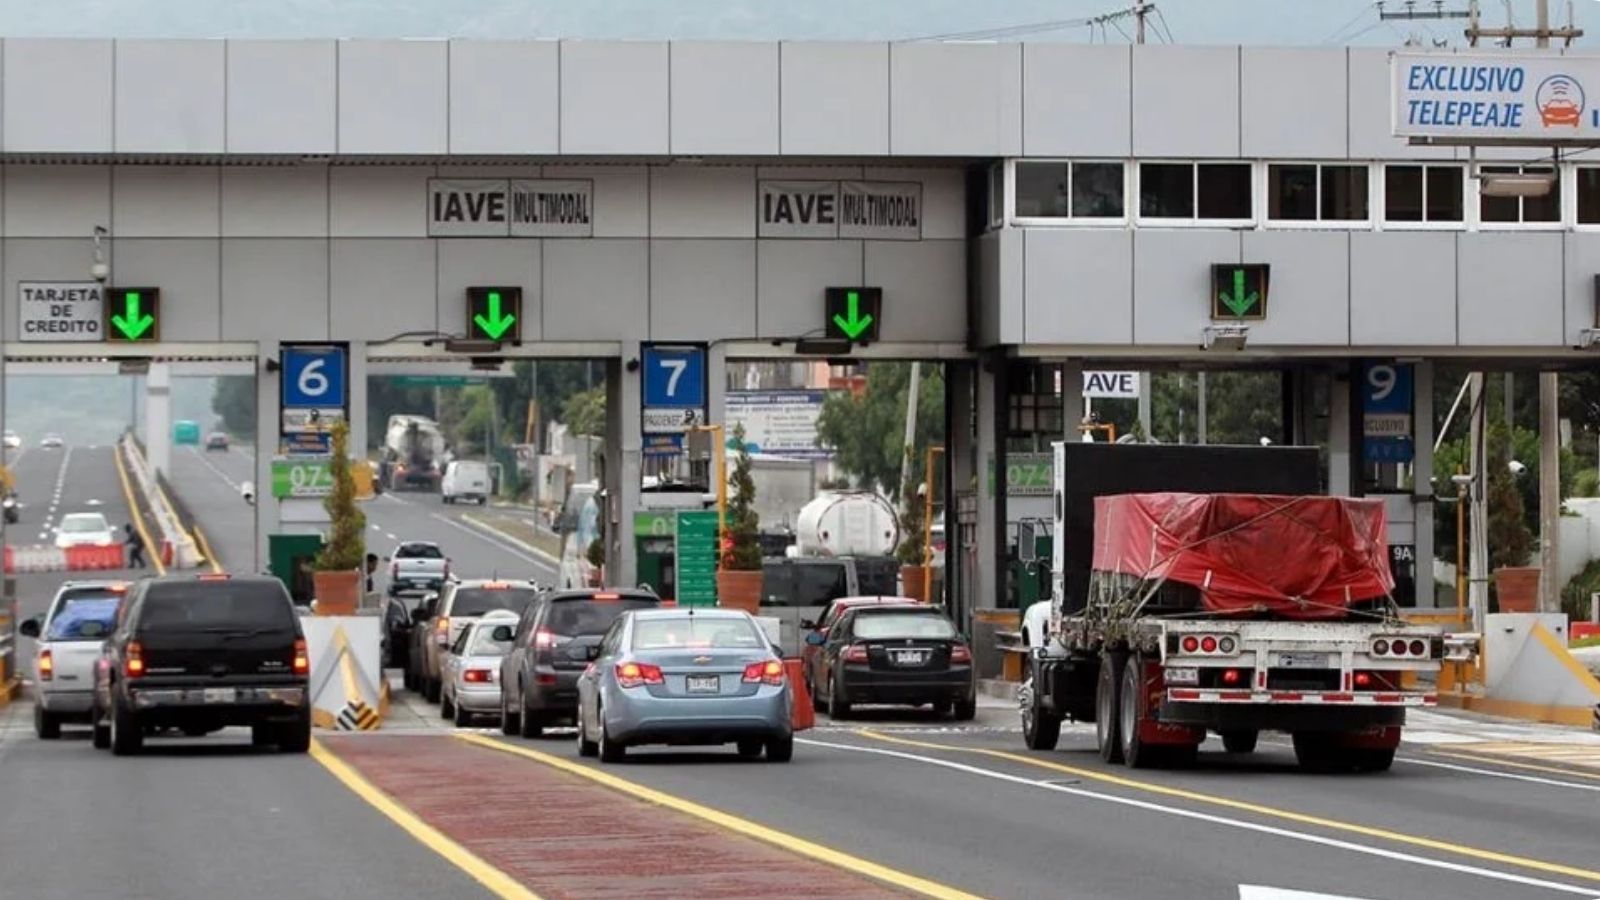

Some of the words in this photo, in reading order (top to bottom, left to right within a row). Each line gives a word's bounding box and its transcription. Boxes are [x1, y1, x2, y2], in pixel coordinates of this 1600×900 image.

[1408, 66, 1524, 92] EXCLUSIVO
[1408, 100, 1523, 127] TELEPEAJE
[434, 192, 505, 222] IAVE
[513, 192, 589, 224] MULTIMODAL
[764, 193, 835, 224] IAVE
[843, 194, 917, 227] MULTIMODAL
[24, 288, 100, 301] TARJETA
[51, 304, 73, 317] DE
[24, 320, 98, 333] CREDITO
[298, 358, 329, 396] 6
[660, 360, 687, 397] 7
[1367, 365, 1397, 401] 9
[1393, 546, 1413, 560] 9A
